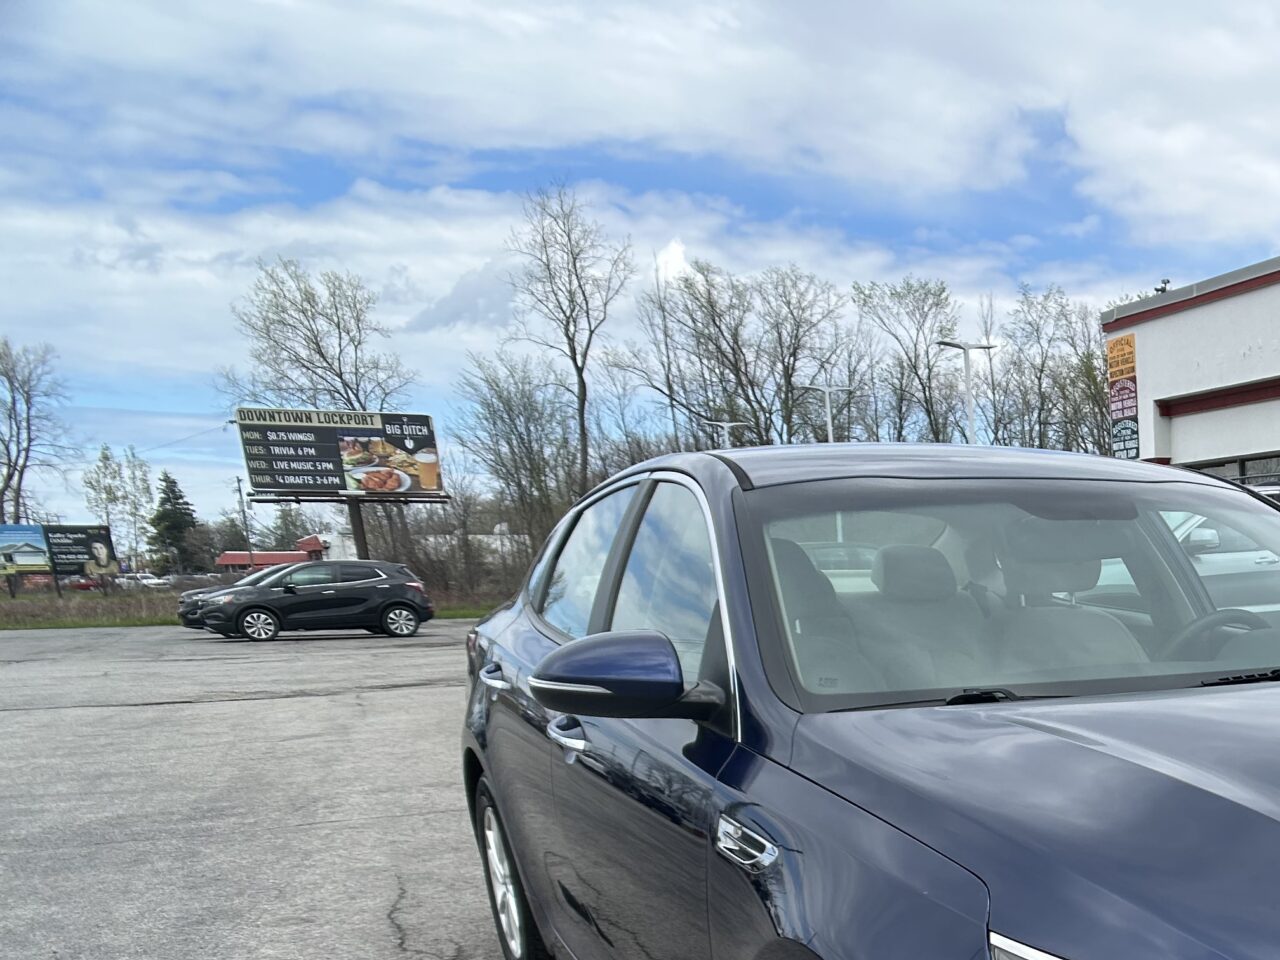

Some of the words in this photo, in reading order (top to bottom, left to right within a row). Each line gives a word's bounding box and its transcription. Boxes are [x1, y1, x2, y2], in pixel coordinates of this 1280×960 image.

[239, 409, 313, 424] DOWNTOWN
[317, 411, 375, 426] LOCKPORT
[385, 424, 401, 434] BIG
[403, 425, 429, 435] DITCH
[267, 431, 286, 440] $0.75
[287, 432, 315, 441] WINGS!
[245, 446, 266, 454] TUES:
[270, 446, 295, 455] TRIVIA
[297, 447, 303, 455] 6
[303, 447, 316, 455] PM
[248, 461, 269, 469] WED:
[272, 461, 289, 469] LIVE
[290, 462, 314, 470] MUSIC
[316, 462, 321, 470] 5
[284, 475, 314, 484] DRAFTS
